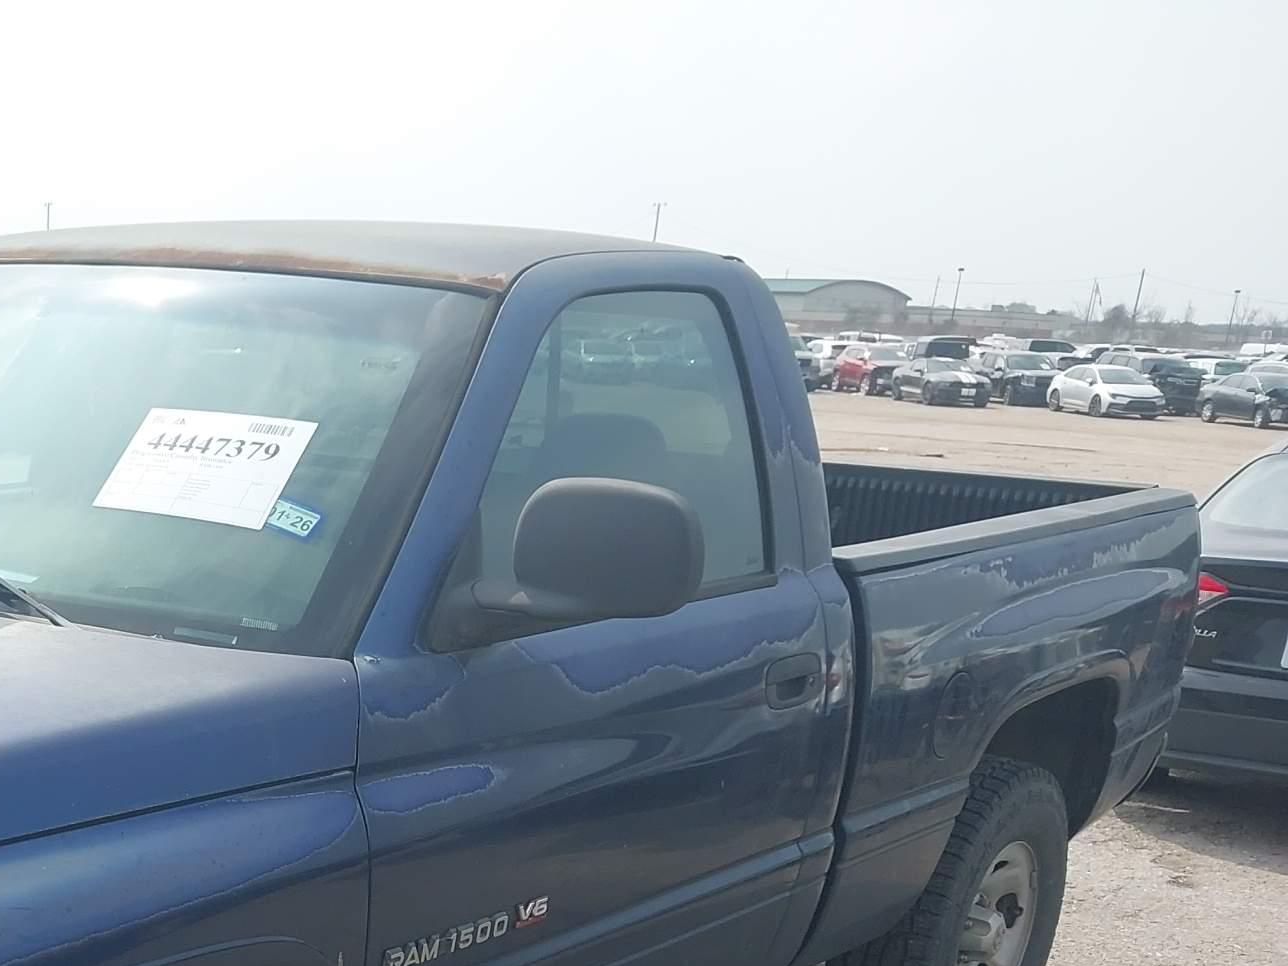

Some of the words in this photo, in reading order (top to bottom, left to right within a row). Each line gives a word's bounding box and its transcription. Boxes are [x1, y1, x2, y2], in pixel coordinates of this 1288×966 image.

[148, 432, 281, 462] 44447379
[289, 515, 314, 532] 26
[448, 911, 509, 953] 1500
[515, 895, 550, 925] V6
